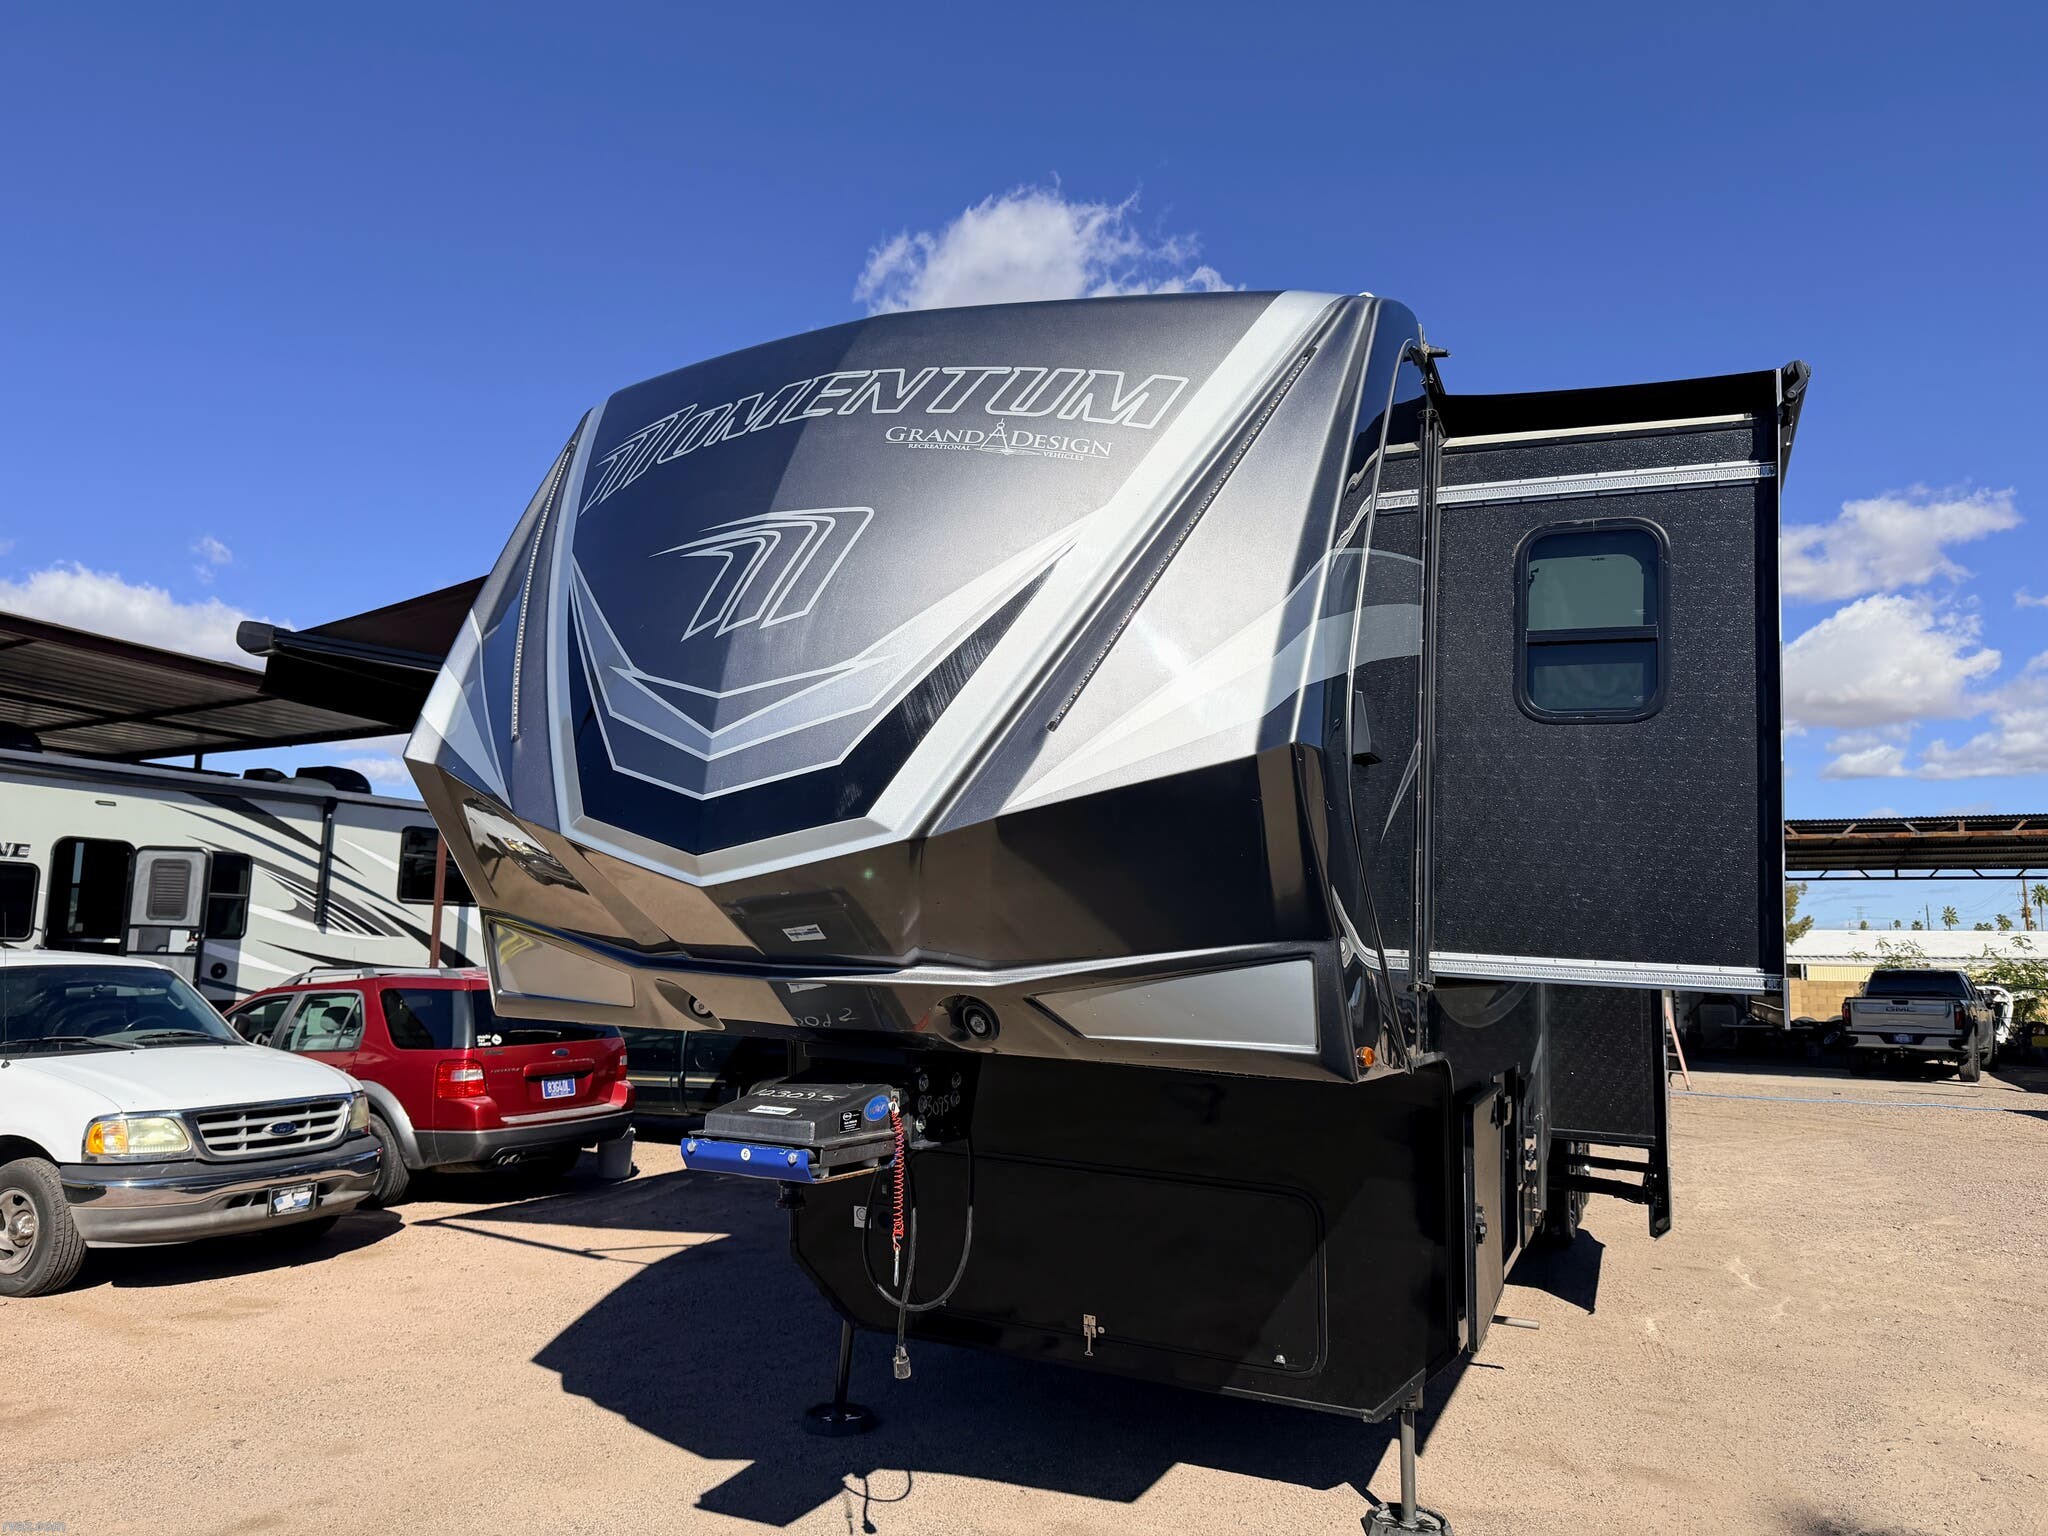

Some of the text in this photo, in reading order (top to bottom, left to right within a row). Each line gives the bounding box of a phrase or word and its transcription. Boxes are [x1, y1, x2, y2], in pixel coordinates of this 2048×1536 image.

[580, 366, 1190, 516] MOMENTUM
[885, 426, 1113, 456] GRAND DESIGN
[908, 443, 971, 451] RECREATIONAL
